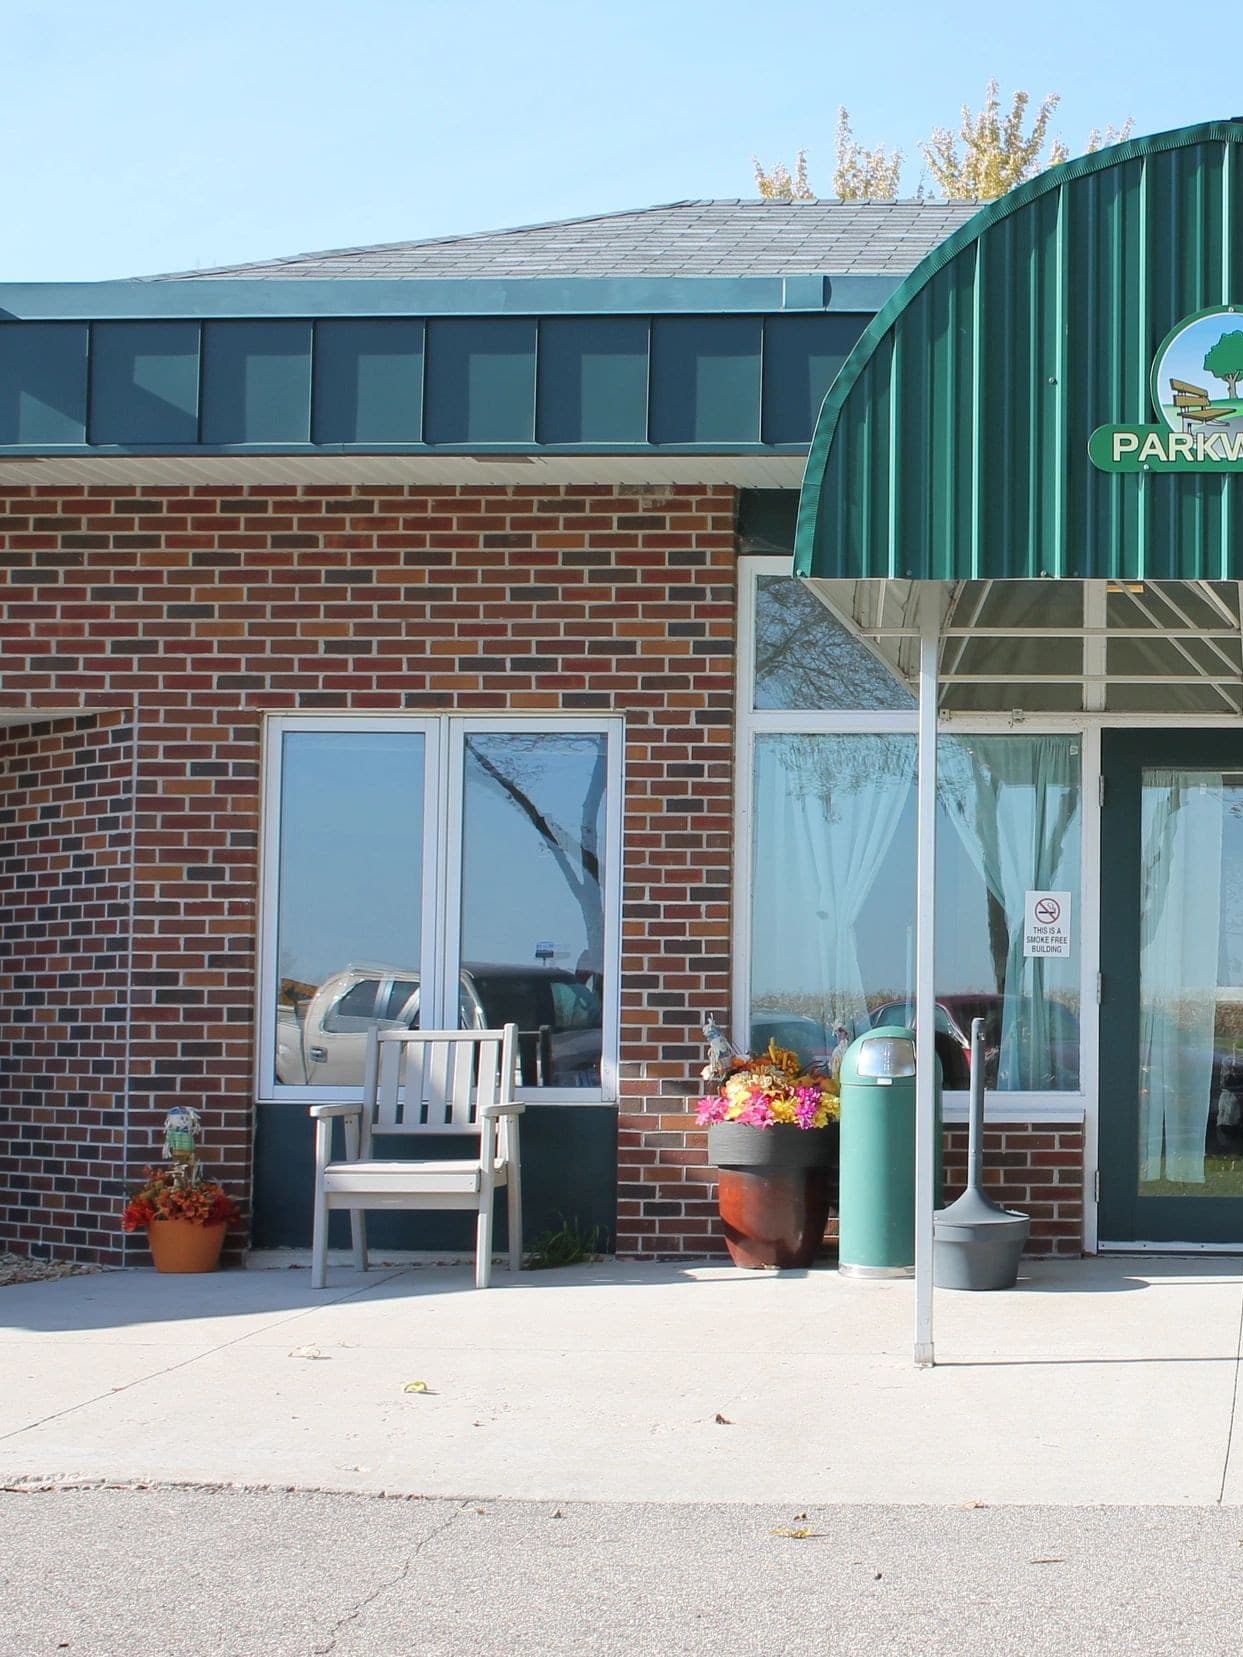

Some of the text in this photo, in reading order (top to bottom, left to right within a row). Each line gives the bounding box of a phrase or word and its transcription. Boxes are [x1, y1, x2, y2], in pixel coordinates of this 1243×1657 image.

[1033, 926, 1061, 935] THIS IS A
[1026, 936, 1068, 944] SMOKE FREE
[1031, 945, 1062, 953] BUILDING
